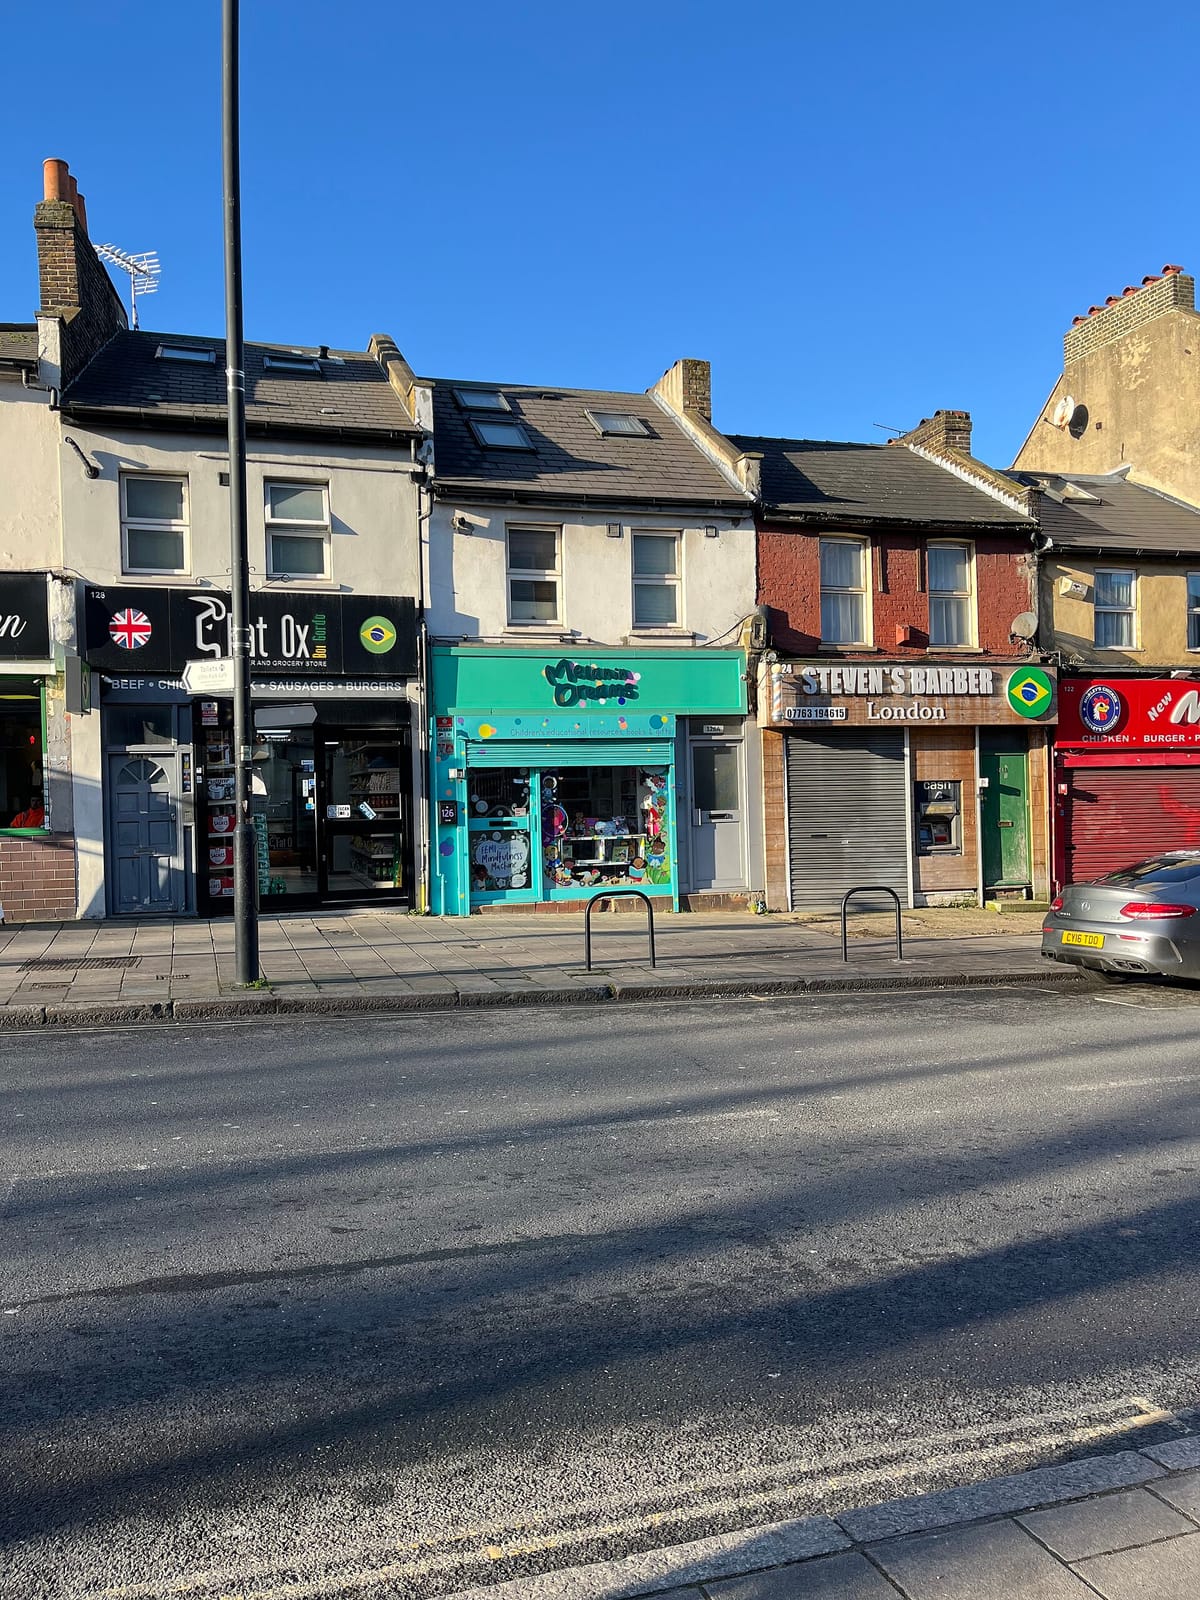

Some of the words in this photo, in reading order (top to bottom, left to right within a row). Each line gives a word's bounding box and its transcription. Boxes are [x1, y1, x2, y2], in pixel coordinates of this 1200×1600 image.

[312, 613, 326, 642] Gordo
[281, 614, 310, 658] Ox
[781, 664, 792, 674] 24
[111, 680, 145, 690] BEEF
[802, 666, 905, 695] STEVEN'S
[910, 667, 993, 695] BARBER
[269, 681, 334, 691] SAUSAGES
[346, 681, 401, 691] BURGERS
[554, 684, 640, 707] Dreams
[867, 702, 946, 720] London
[1147, 692, 1173, 721] New
[786, 708, 812, 719] 07763
[814, 708, 845, 718] 194615
[1082, 735, 1130, 743] CHICKEN
[1143, 734, 1186, 742] BURGER
[441, 809, 455, 817] 126
[482, 851, 523, 863] Mindfulness
[1066, 932, 1082, 942] CY16
